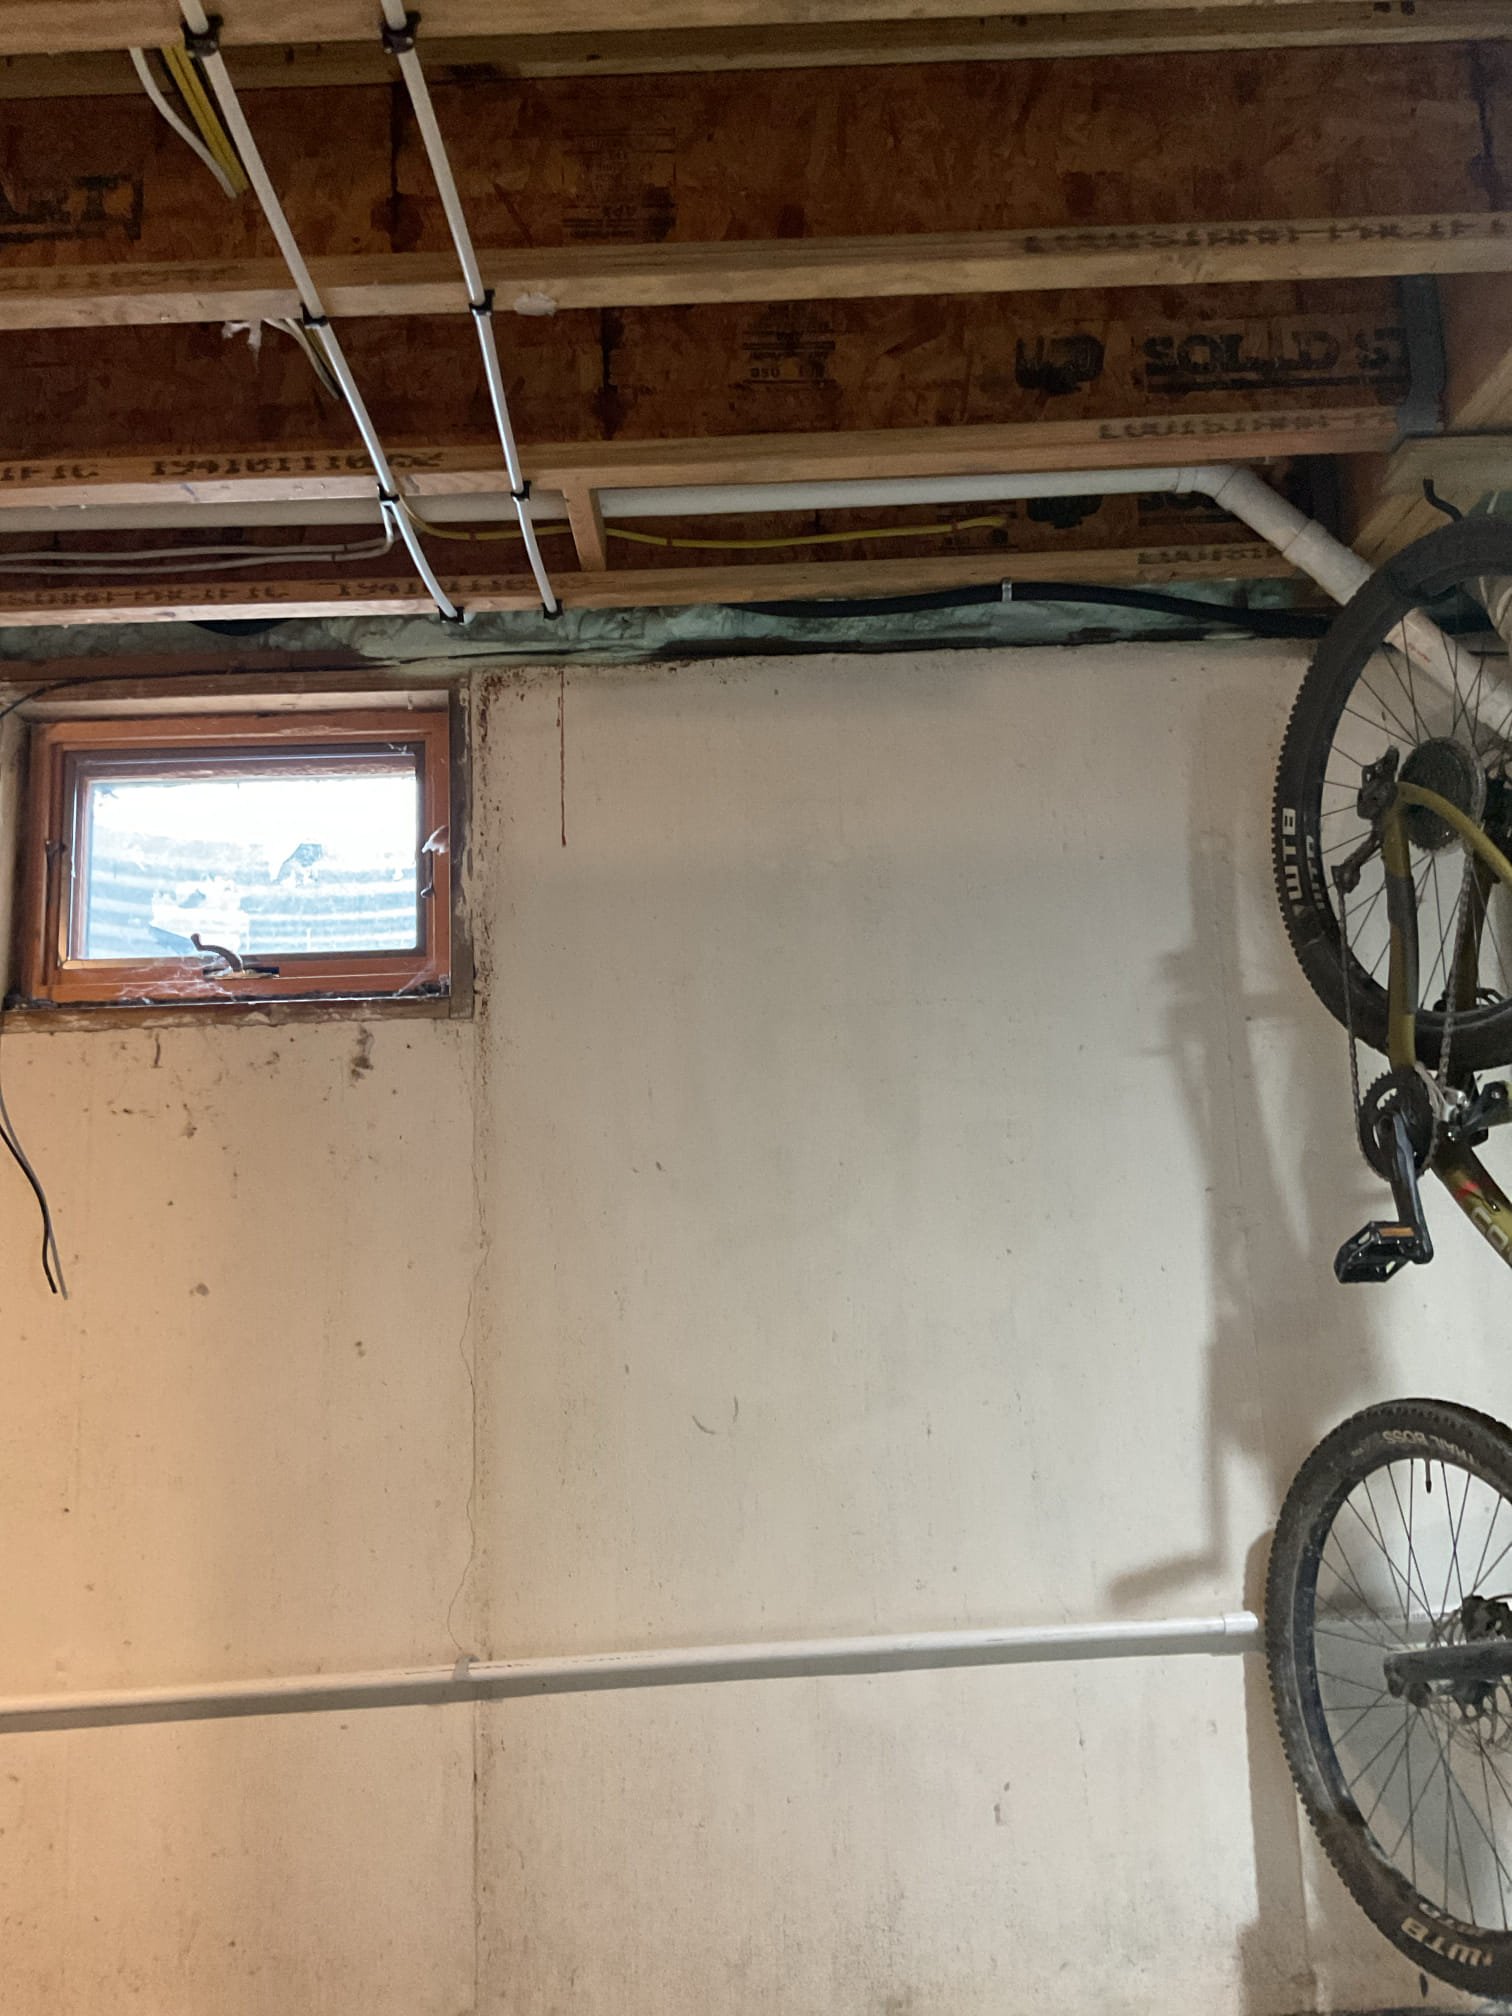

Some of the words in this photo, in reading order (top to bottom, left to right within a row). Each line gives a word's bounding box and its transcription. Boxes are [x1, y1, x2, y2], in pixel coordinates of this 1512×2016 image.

[1281, 807, 1304, 901] WTB
[1382, 1429, 1427, 1446] BOSS
[1400, 1916, 1483, 1966] WTB
